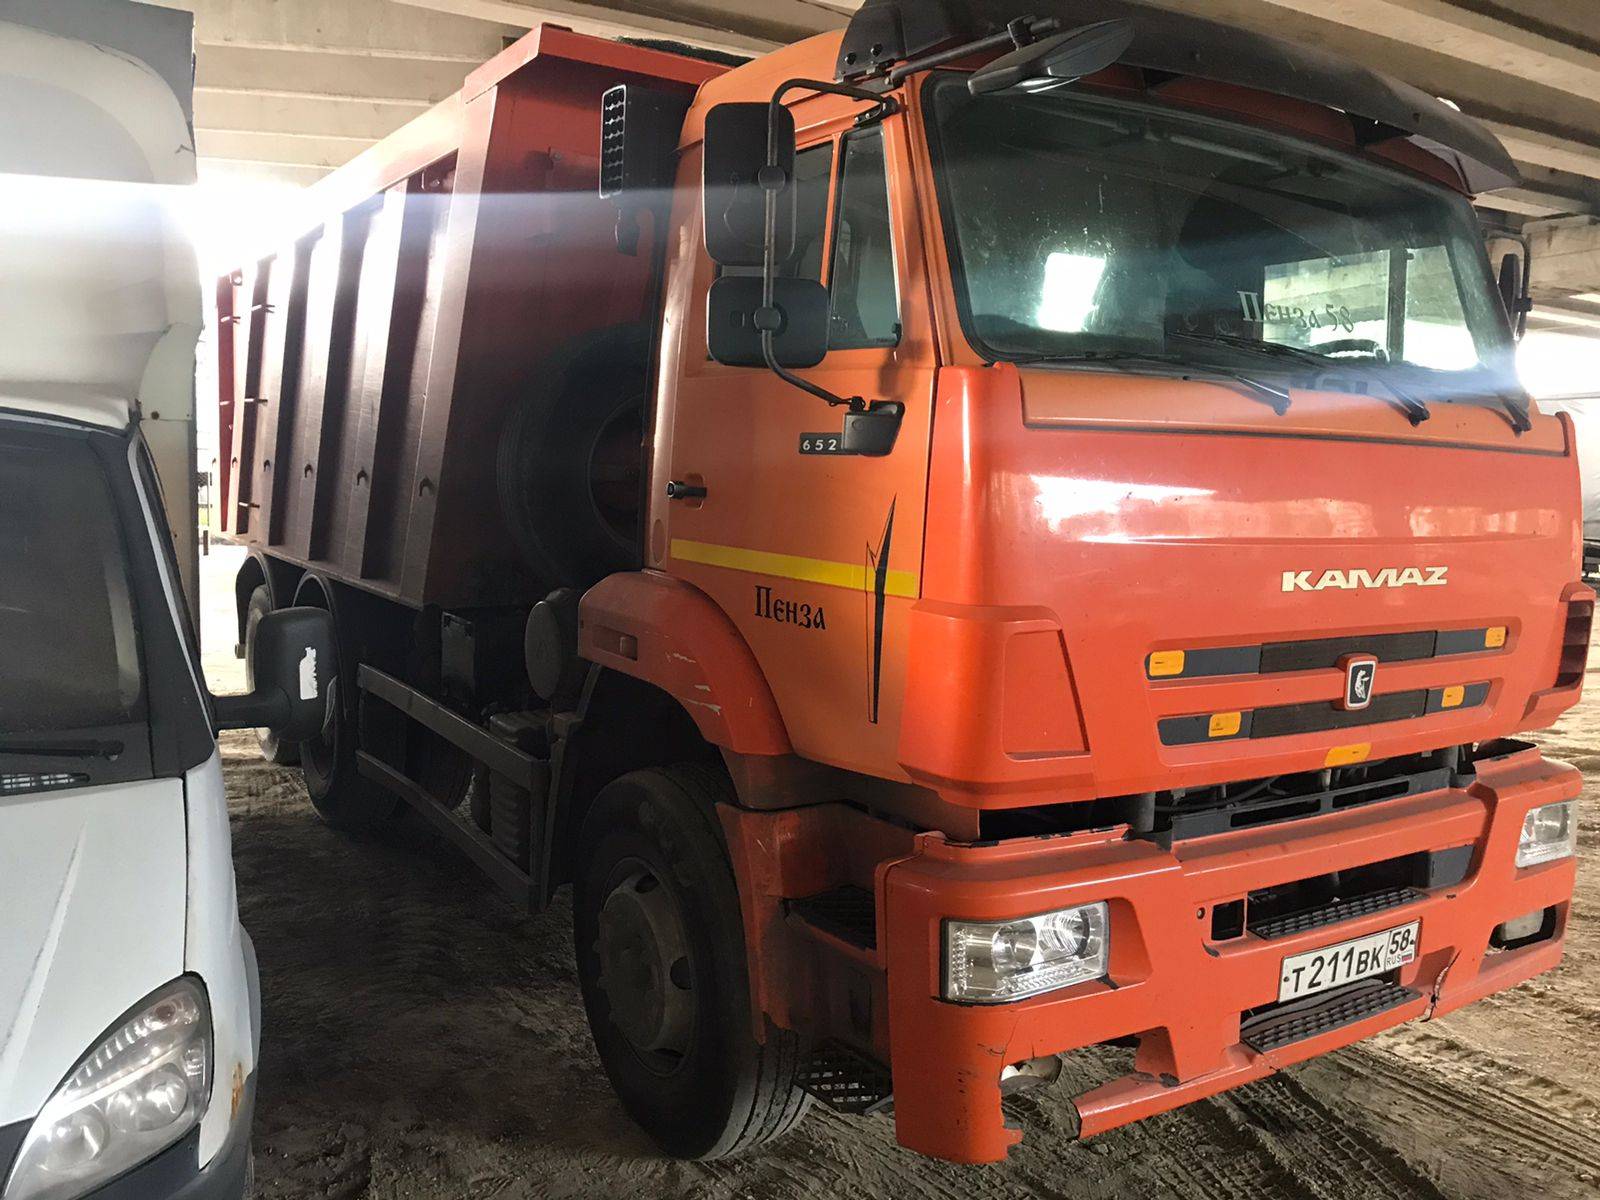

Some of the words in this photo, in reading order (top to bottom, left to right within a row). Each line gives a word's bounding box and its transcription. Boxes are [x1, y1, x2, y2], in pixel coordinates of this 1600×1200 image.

[1325, 303, 1354, 333] 58
[1281, 566, 1449, 592] KAMAZ
[1389, 928, 1411, 955] 58
[1386, 952, 1401, 966] RUS
